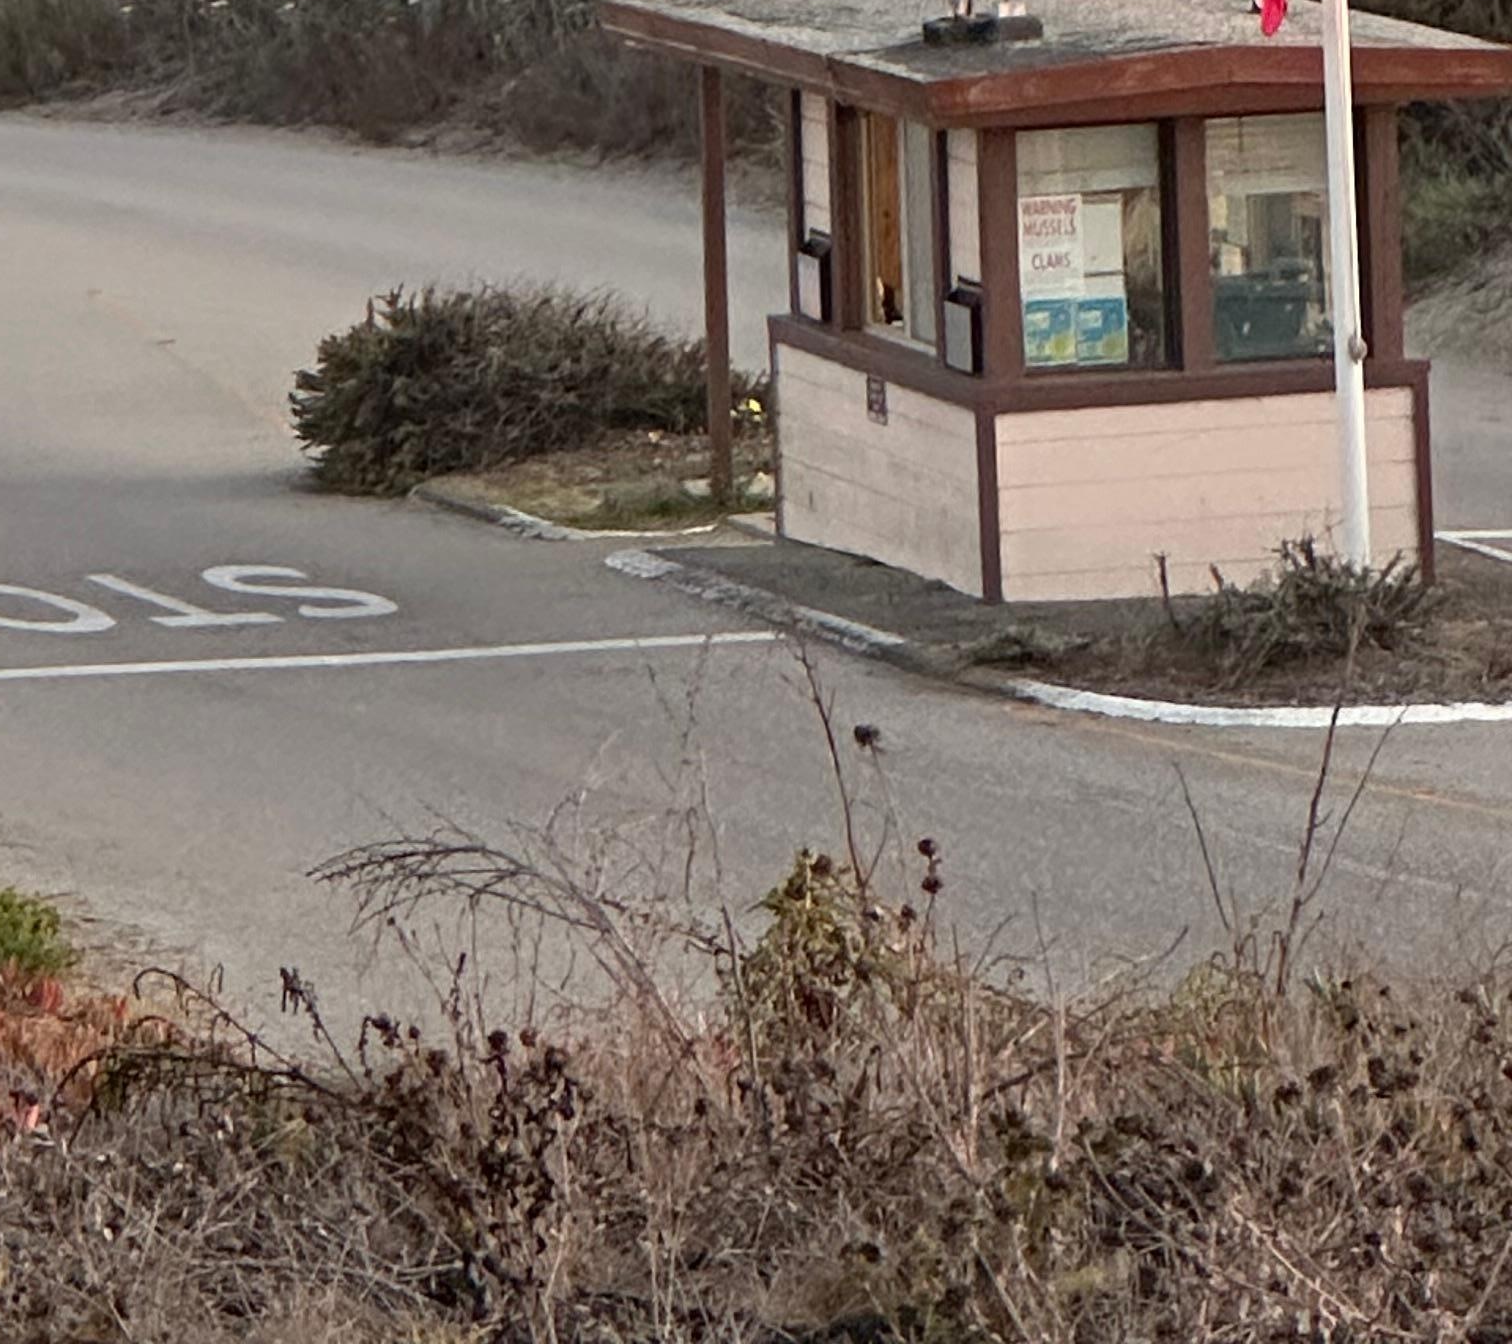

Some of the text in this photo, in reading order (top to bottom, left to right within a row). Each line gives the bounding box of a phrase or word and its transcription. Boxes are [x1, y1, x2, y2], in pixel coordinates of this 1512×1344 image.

[1021, 198, 1077, 216] WARNING
[1023, 217, 1076, 237] MUSSELS
[1031, 253, 1071, 271] CLAMS
